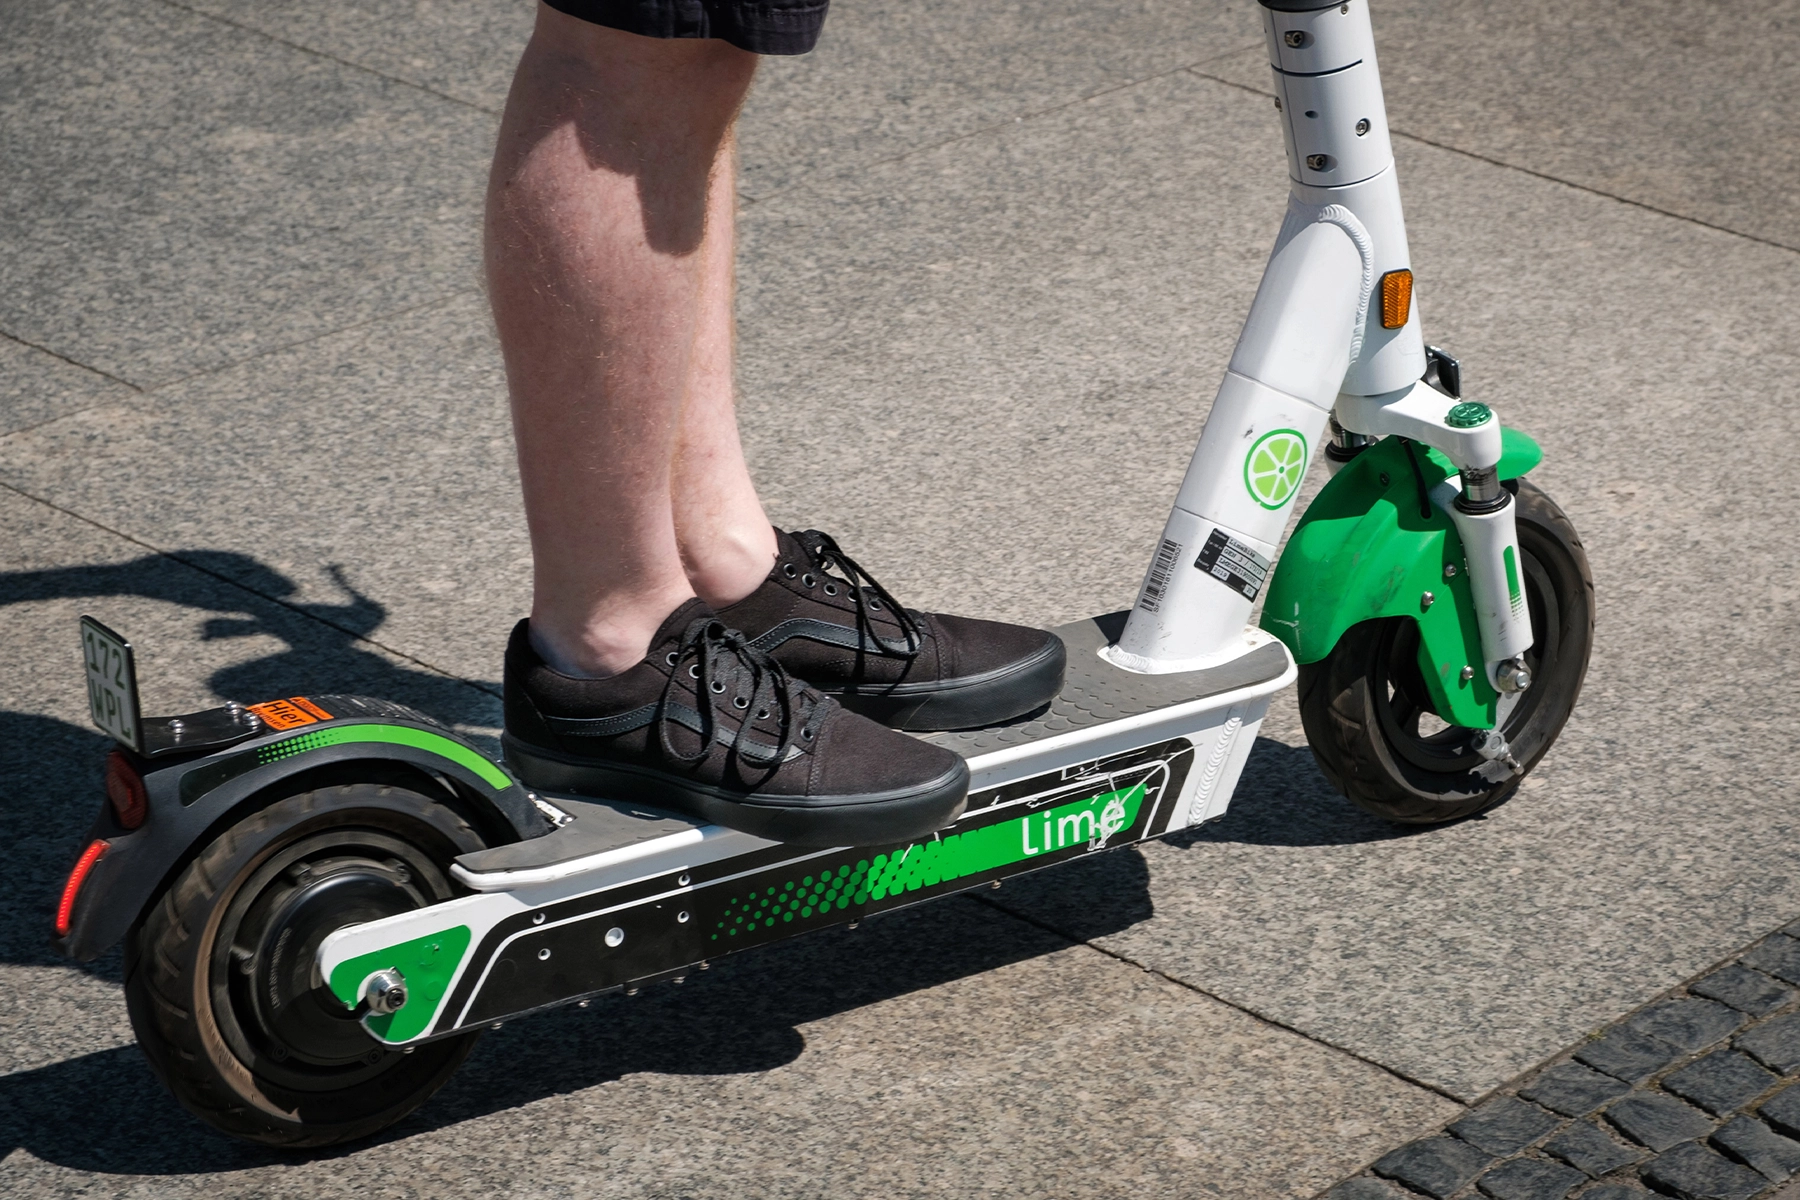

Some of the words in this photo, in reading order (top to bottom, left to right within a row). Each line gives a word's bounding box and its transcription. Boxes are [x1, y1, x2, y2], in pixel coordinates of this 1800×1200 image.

[87, 632, 126, 690] 172
[91, 679, 131, 739] WPL
[262, 702, 306, 724] Hier
[1022, 800, 1125, 855] Lime
